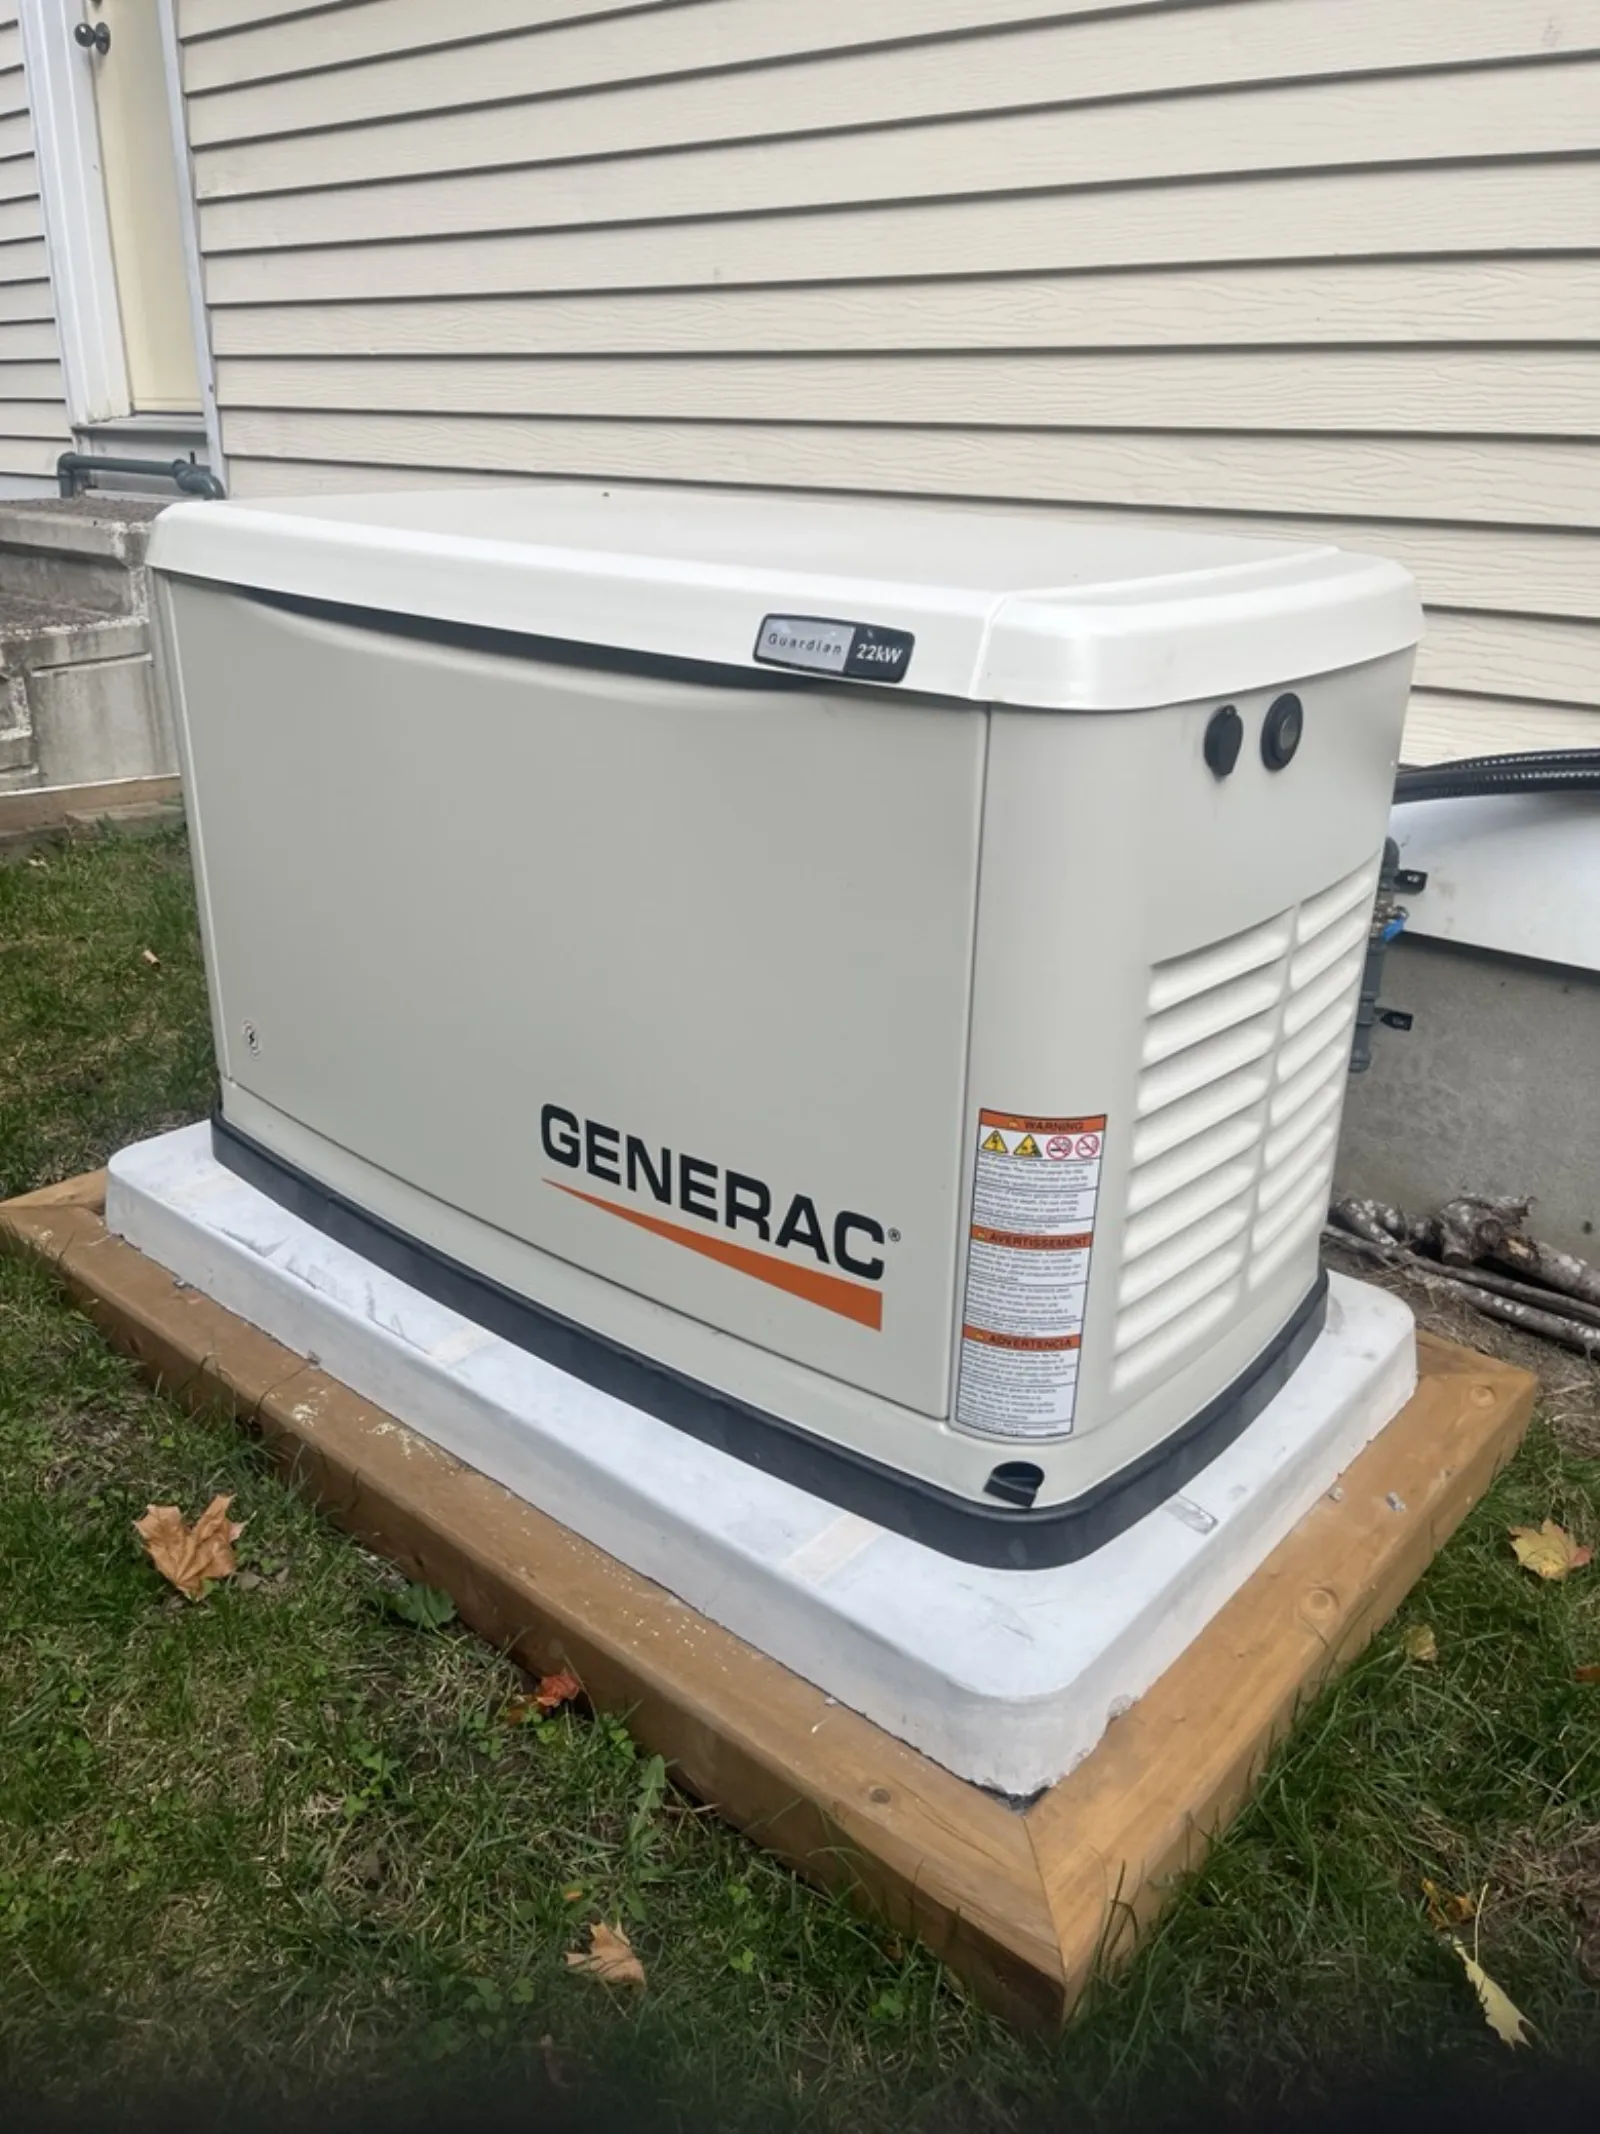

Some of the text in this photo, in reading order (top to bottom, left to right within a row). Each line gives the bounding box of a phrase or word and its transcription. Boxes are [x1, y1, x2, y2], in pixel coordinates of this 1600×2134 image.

[767, 632, 903, 664] Guardian 22kW
[1025, 1120, 1085, 1132] WARNING
[989, 1231, 1087, 1247] AVERTISSEMENT
[988, 1334, 1073, 1349] ADVERTENCIA
